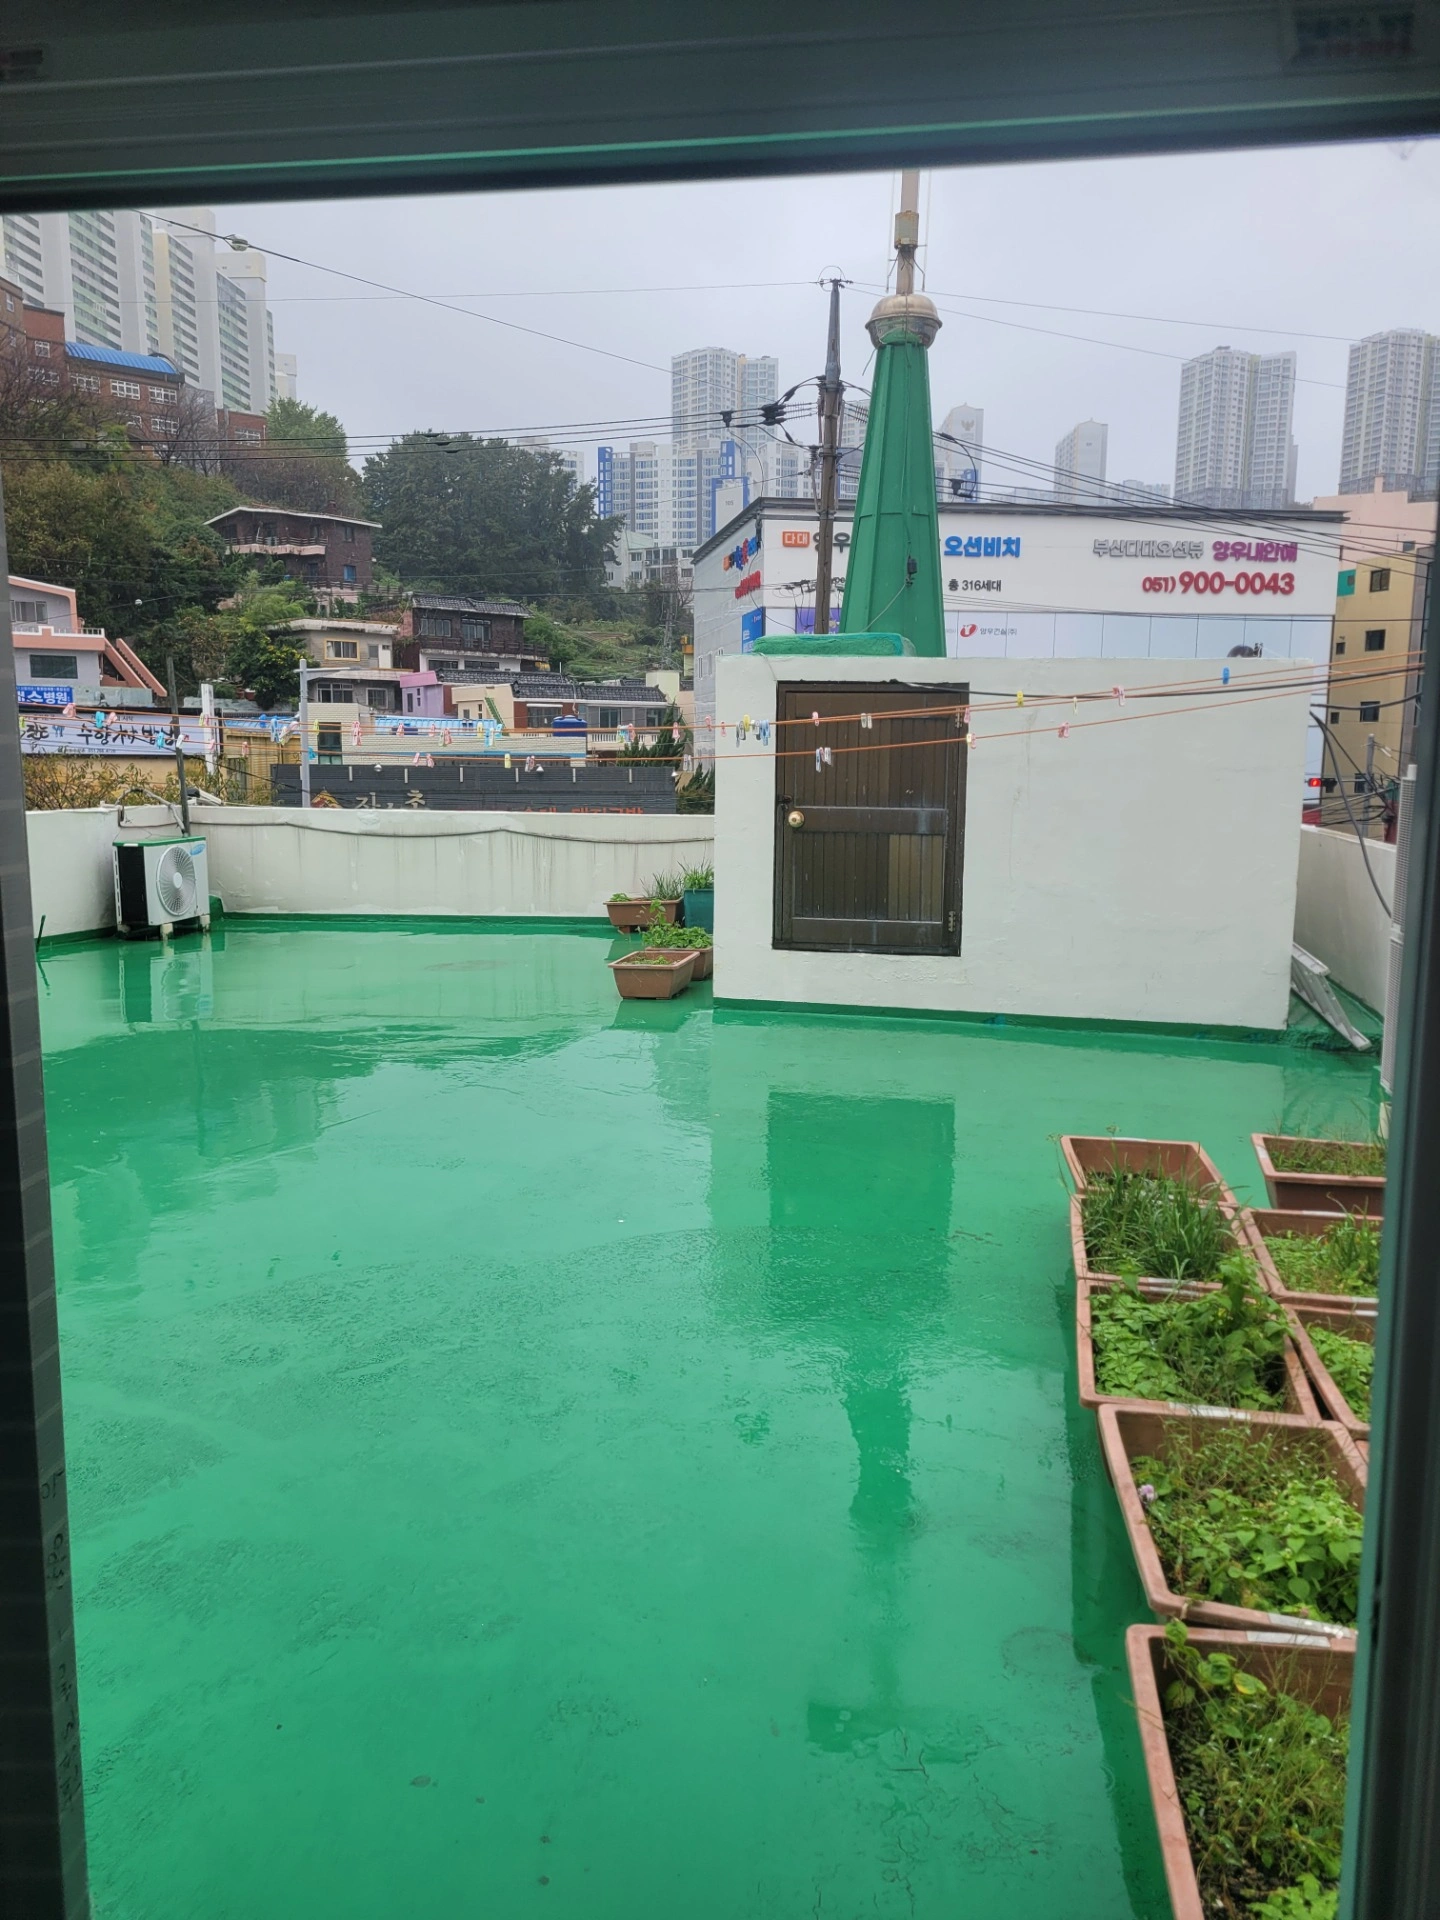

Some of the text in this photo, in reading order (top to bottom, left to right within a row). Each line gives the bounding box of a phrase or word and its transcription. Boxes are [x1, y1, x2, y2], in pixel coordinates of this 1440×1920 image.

[784, 532, 809, 546] 다대
[944, 536, 1021, 558] 오션비치
[1093, 539, 1204, 559] 부산다대오션뷰
[948, 579, 1002, 592] 총 316세대
[1142, 571, 1295, 595] 051) 900-0043
